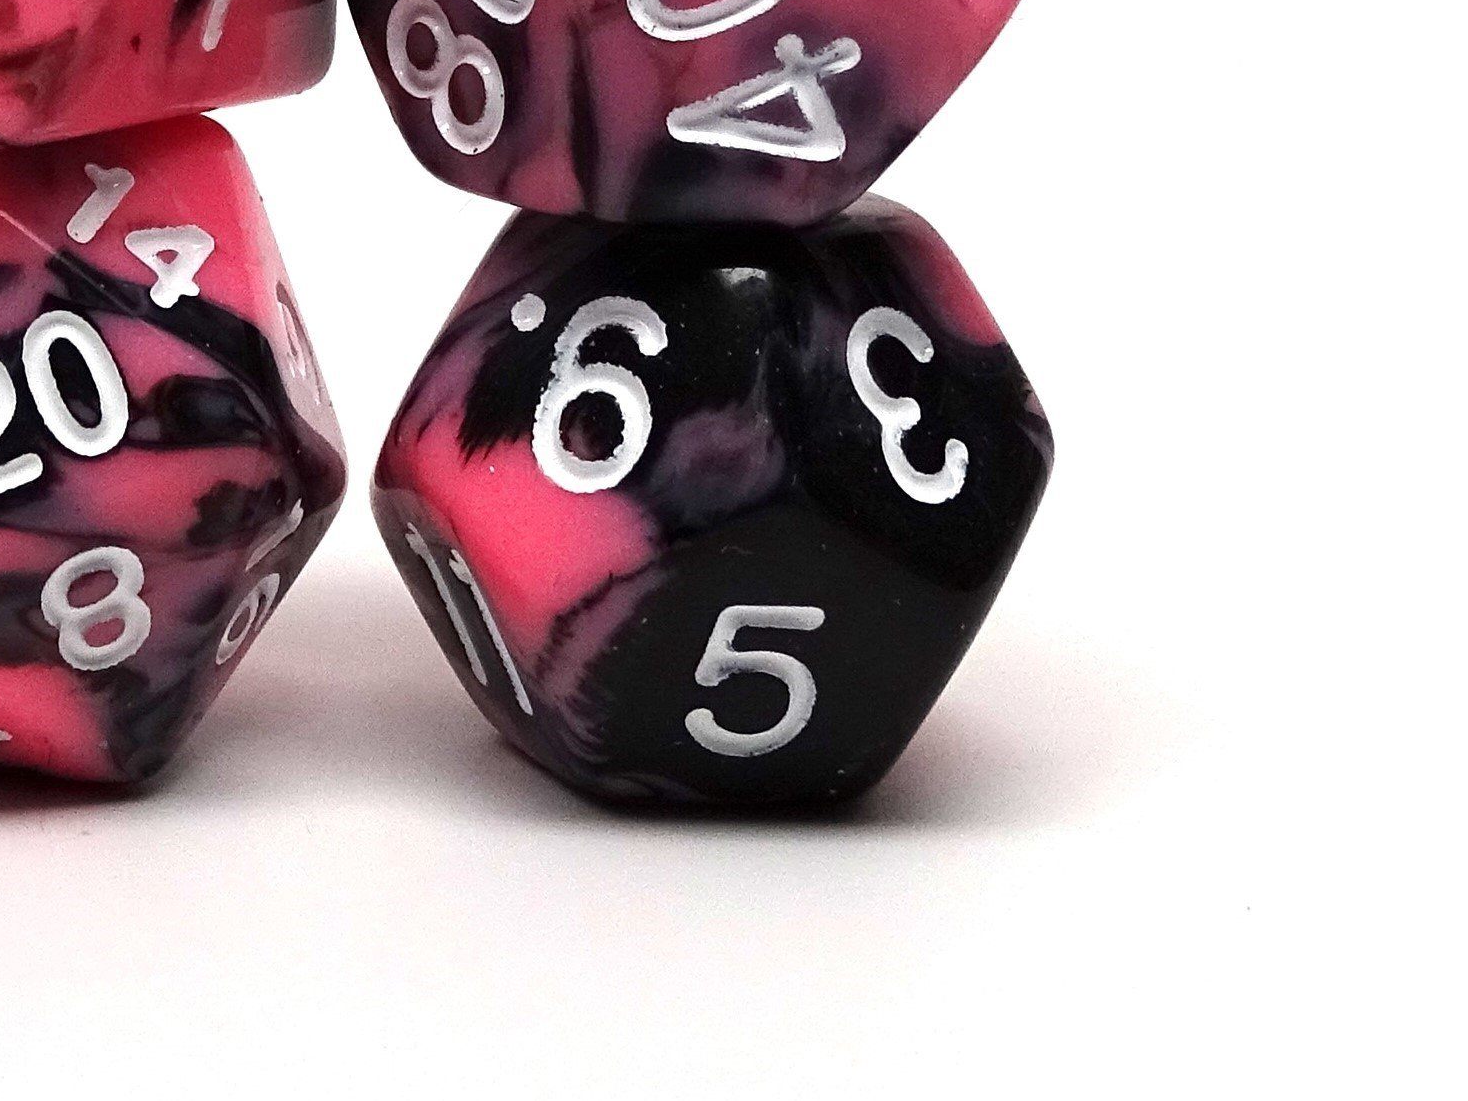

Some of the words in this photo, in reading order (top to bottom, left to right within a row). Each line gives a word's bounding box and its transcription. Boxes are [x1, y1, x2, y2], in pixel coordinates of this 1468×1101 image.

[67, 164, 214, 307] 14
[846, 307, 968, 504] 3
[41, 546, 151, 670] 8
[404, 522, 532, 715] 11
[685, 605, 825, 757] 5
